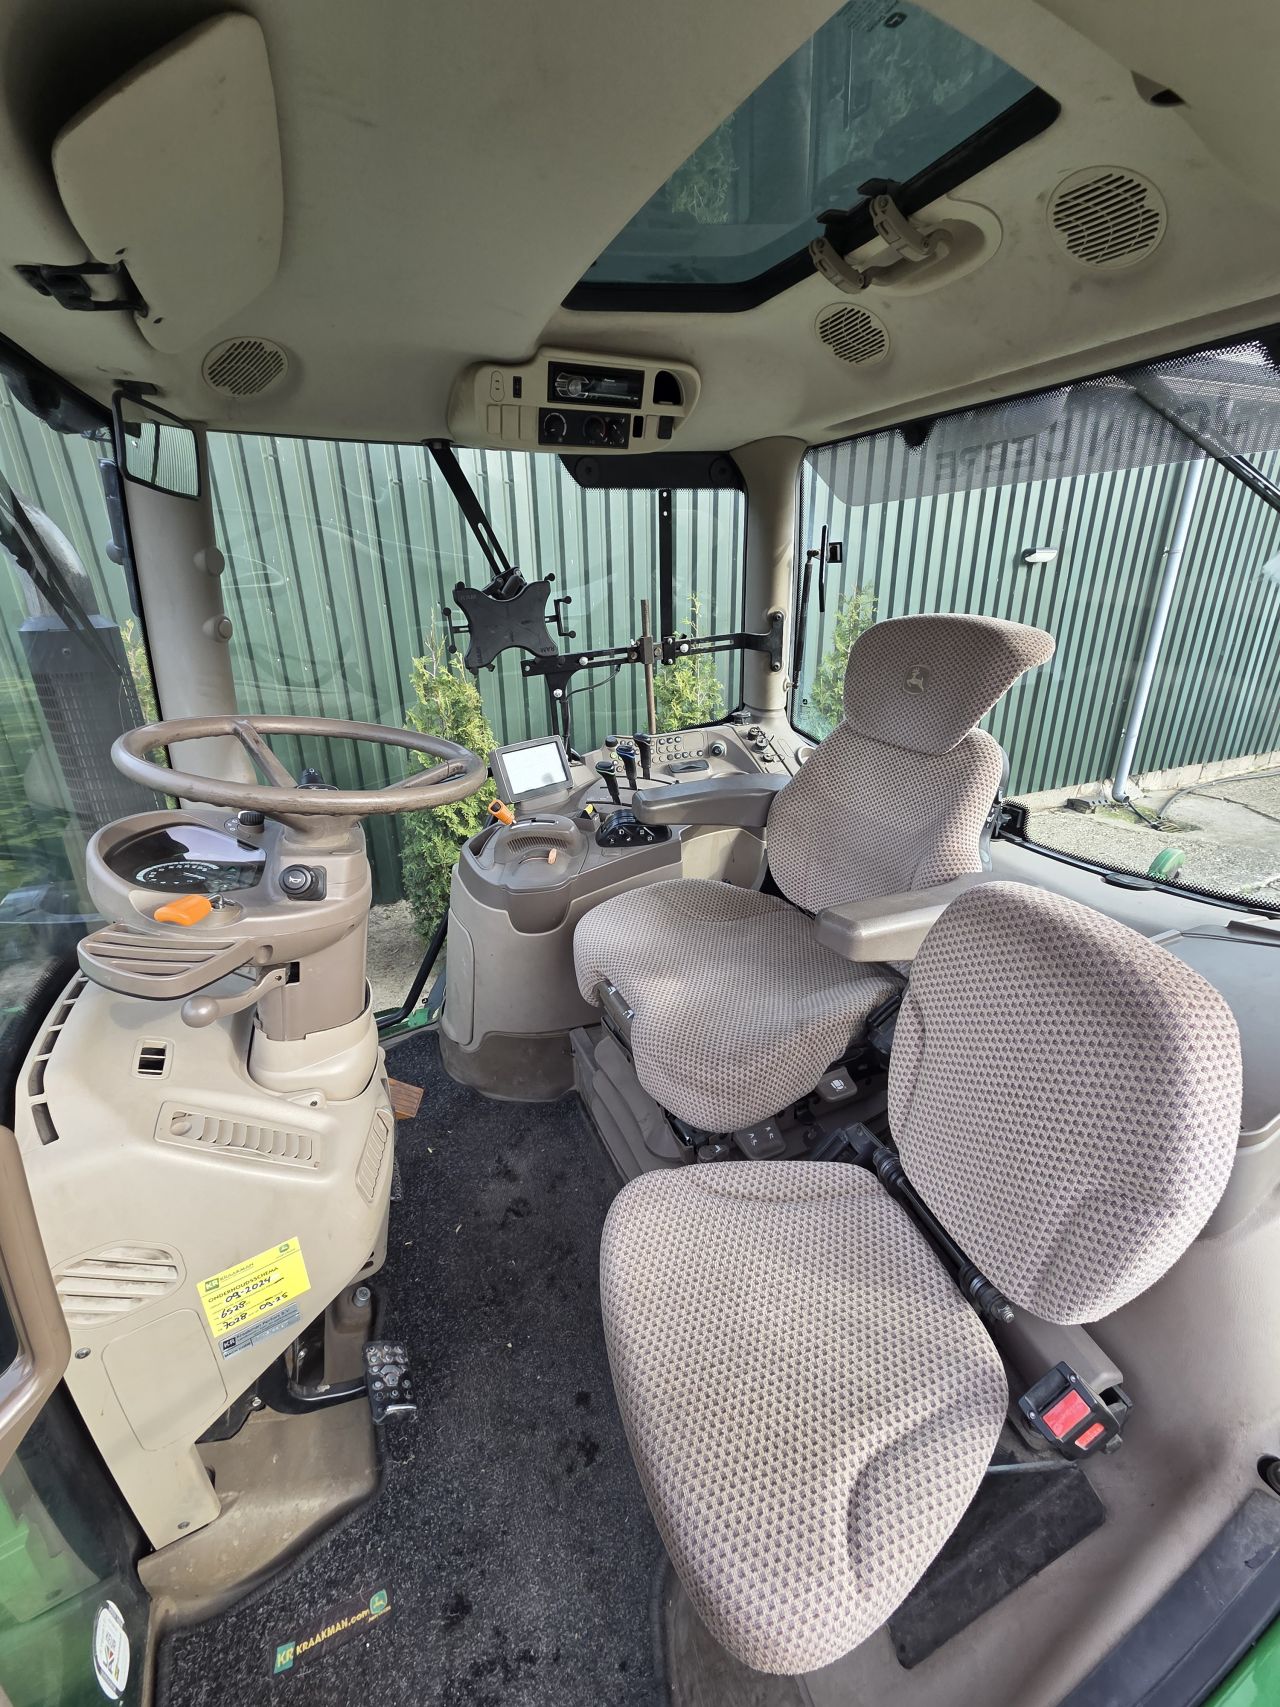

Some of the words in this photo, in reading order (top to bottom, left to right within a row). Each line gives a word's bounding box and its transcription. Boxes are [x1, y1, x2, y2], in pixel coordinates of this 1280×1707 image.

[225, 1276, 271, 1303] 09-2024
[276, 1646, 295, 1668] KR
[295, 1608, 370, 1657] KRAAKMAN.com
